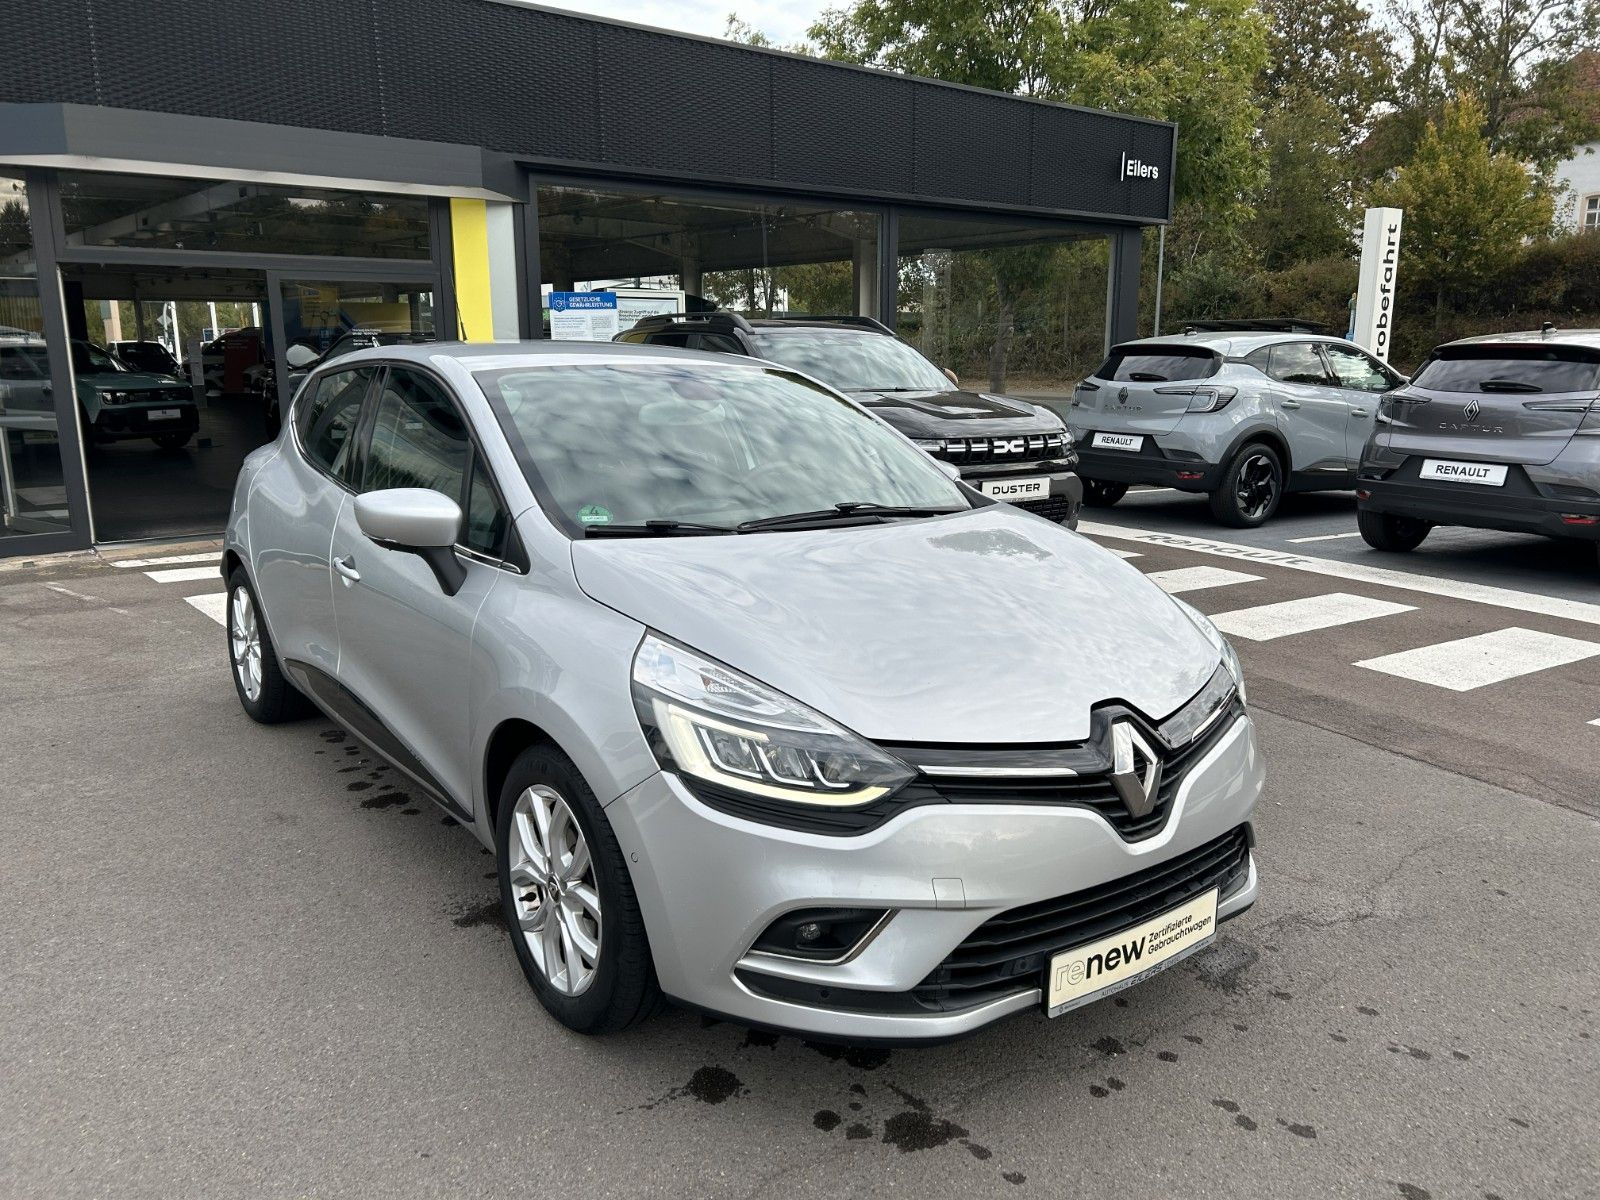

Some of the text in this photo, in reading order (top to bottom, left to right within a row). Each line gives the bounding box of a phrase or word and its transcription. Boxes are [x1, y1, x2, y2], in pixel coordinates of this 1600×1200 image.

[1126, 159, 1159, 179] Eilers
[1376, 223, 1398, 357] robefahrt
[1439, 422, 1504, 433] CAPTUR
[1101, 436, 1134, 446] RENAULT
[1436, 464, 1490, 478] RENAULT
[992, 483, 1041, 495] DUSTER
[1135, 534, 1313, 565] Renault
[1148, 914, 1193, 943] Zertifizierte
[1148, 915, 1212, 955] Gebrauchtwagen
[1055, 936, 1146, 992] renew
